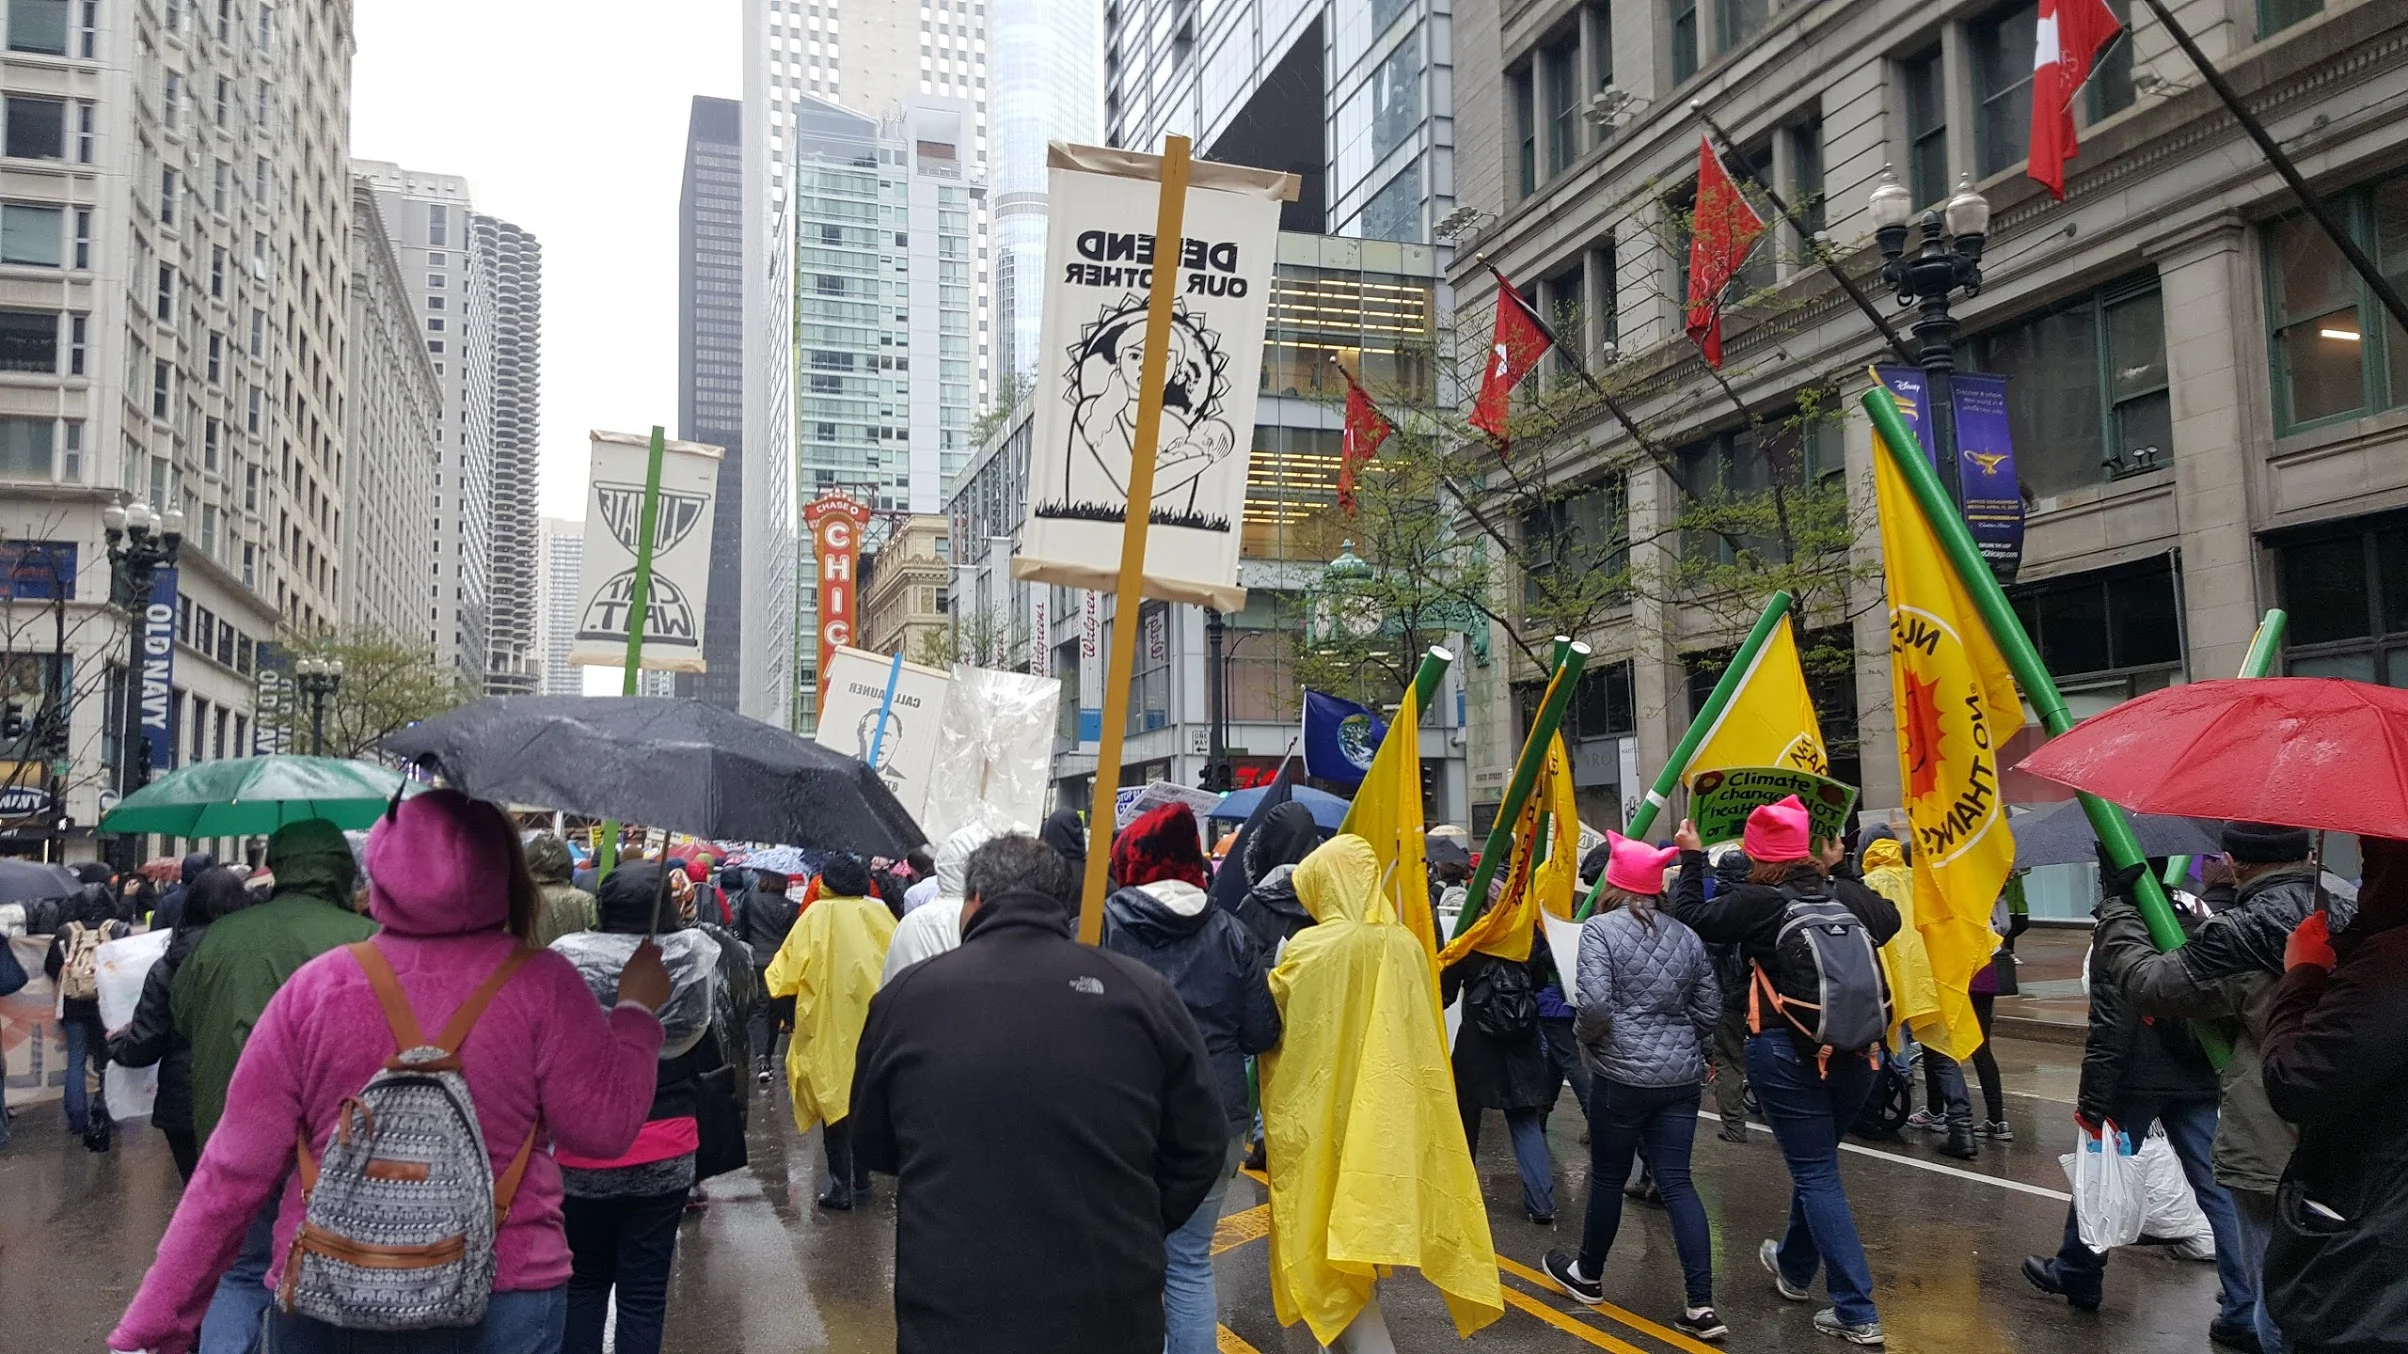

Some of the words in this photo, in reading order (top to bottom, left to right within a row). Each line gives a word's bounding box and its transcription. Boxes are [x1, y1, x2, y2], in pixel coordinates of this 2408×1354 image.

[816, 501, 849, 513] CHASE
[145, 603, 172, 655] OLD
[824, 521, 850, 706] CHIC
[1081, 588, 1100, 659] Walgree
[141, 660, 169, 730] NAVY
[258, 669, 278, 709] OLD
[1729, 772, 1811, 792] Climate
[1706, 825, 1725, 837] or
[1810, 816, 1838, 841] IDS
